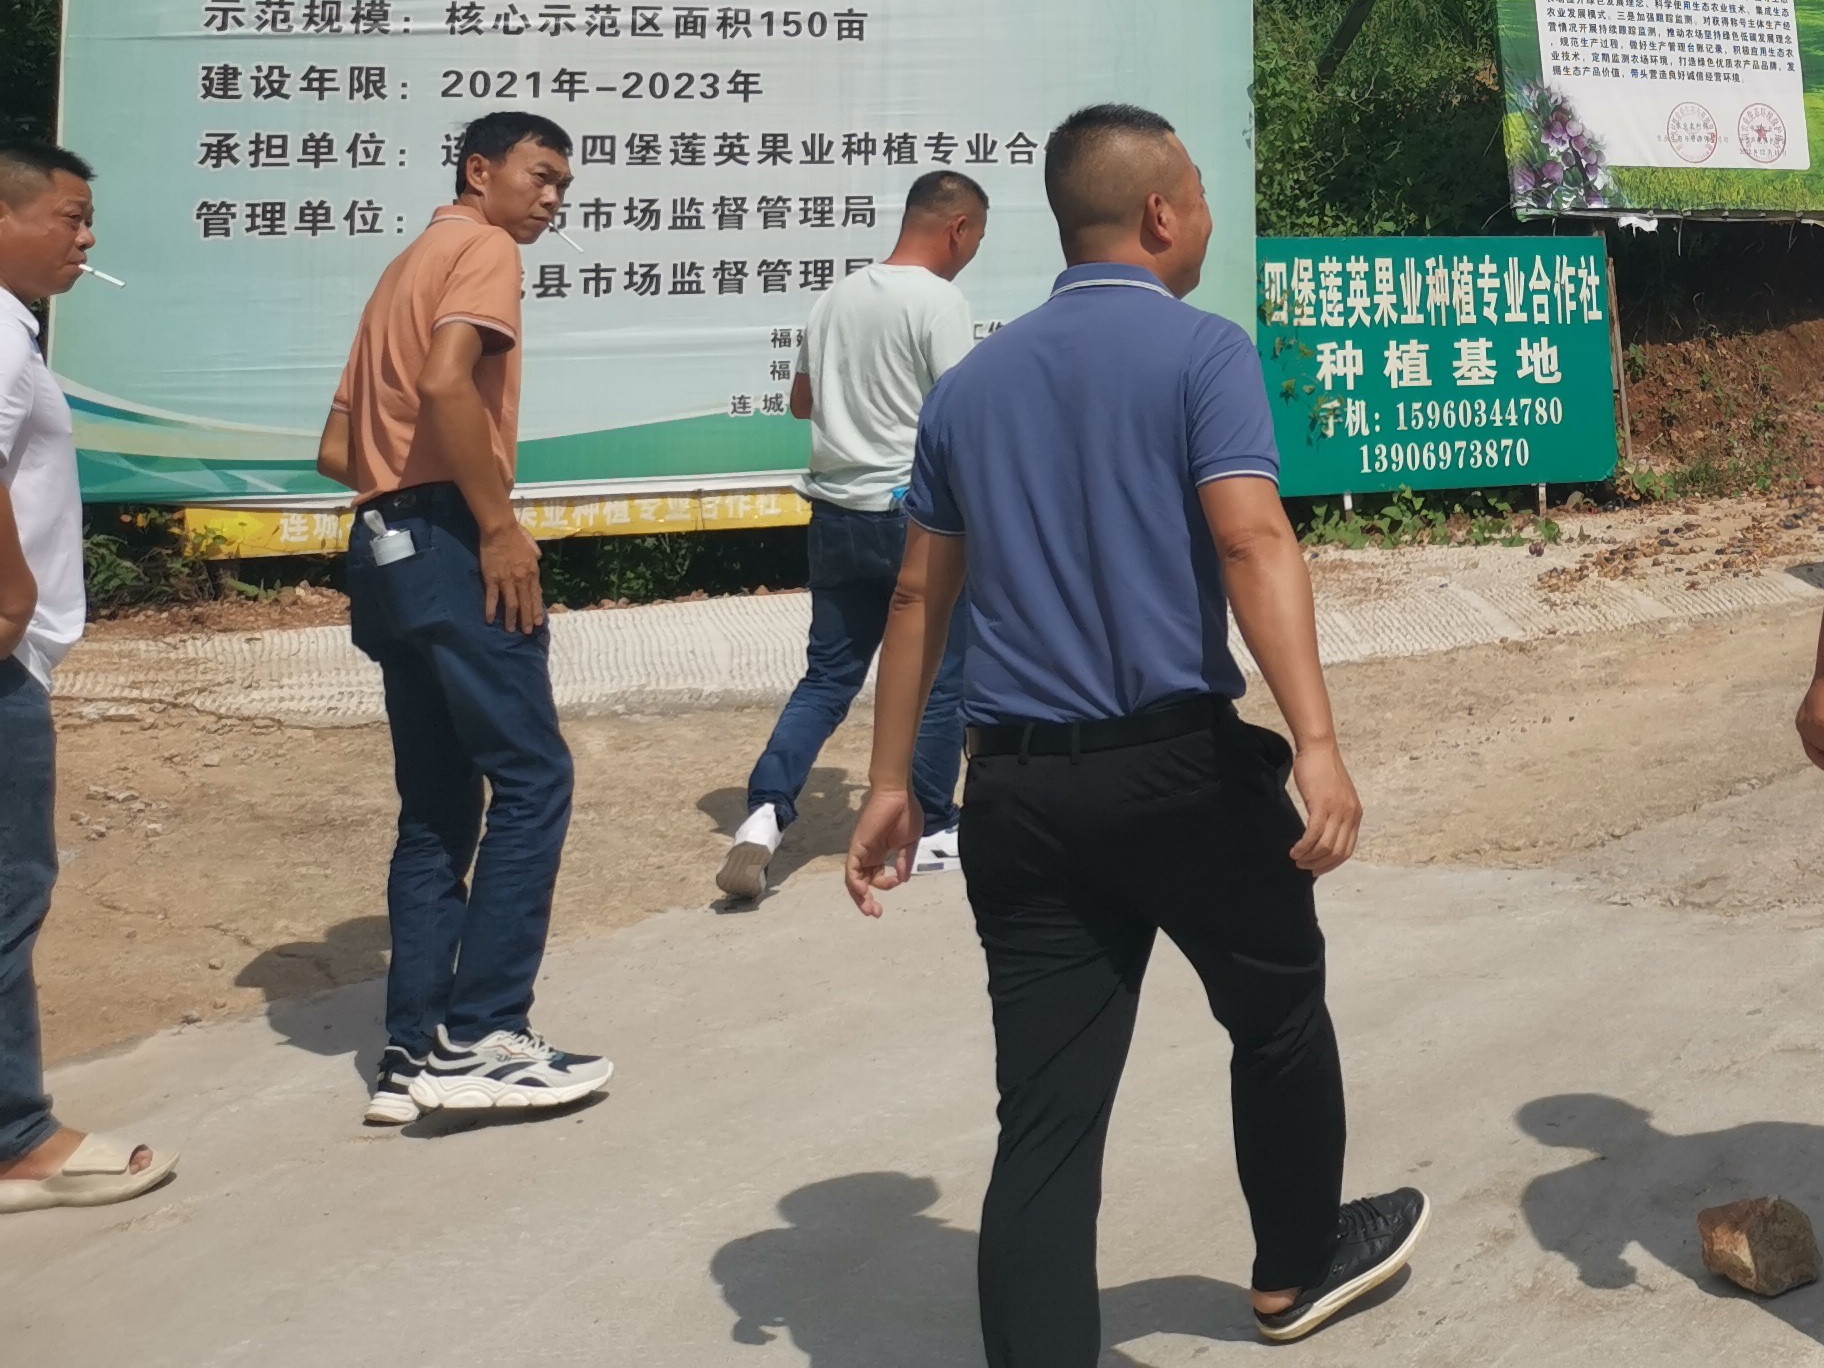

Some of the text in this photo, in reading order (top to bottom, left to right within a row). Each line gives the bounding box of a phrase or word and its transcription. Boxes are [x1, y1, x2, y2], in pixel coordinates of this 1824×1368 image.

[1264, 254, 1602, 328] 四堡莲英果业种植专业合作社
[1316, 336, 1562, 391] 种植基地
[1360, 438, 1529, 474] 13906973870
